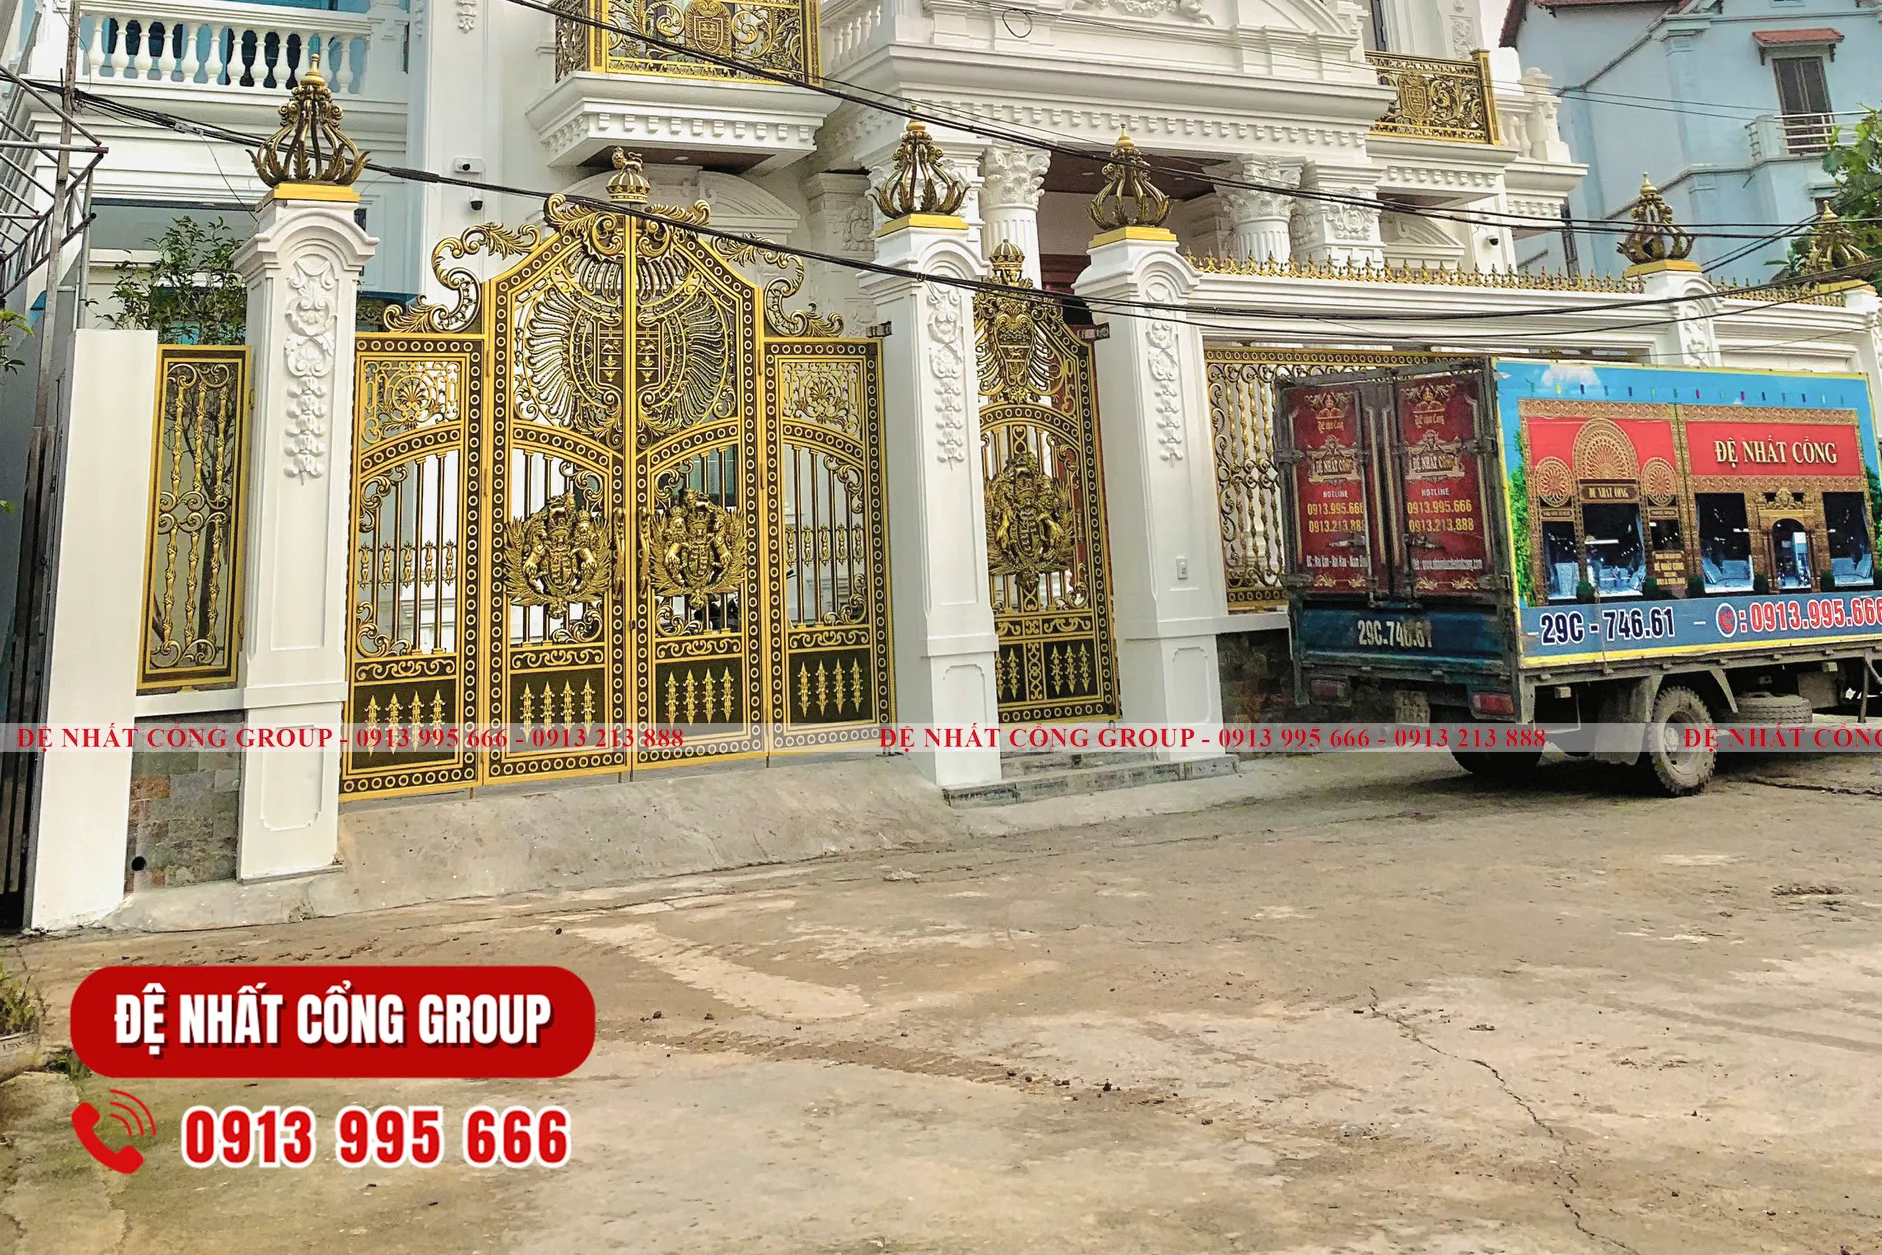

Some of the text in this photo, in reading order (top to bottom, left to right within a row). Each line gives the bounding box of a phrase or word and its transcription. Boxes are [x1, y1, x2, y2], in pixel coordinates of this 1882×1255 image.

[1323, 490, 1349, 498] HOTLINE
[1421, 487, 1450, 497] HOTLINE
[1406, 498, 1472, 515] 0913.995.666
[1408, 517, 1474, 533] 0913.213.888
[1541, 611, 1584, 646] 29C
[1602, 606, 1676, 642] 746.61
